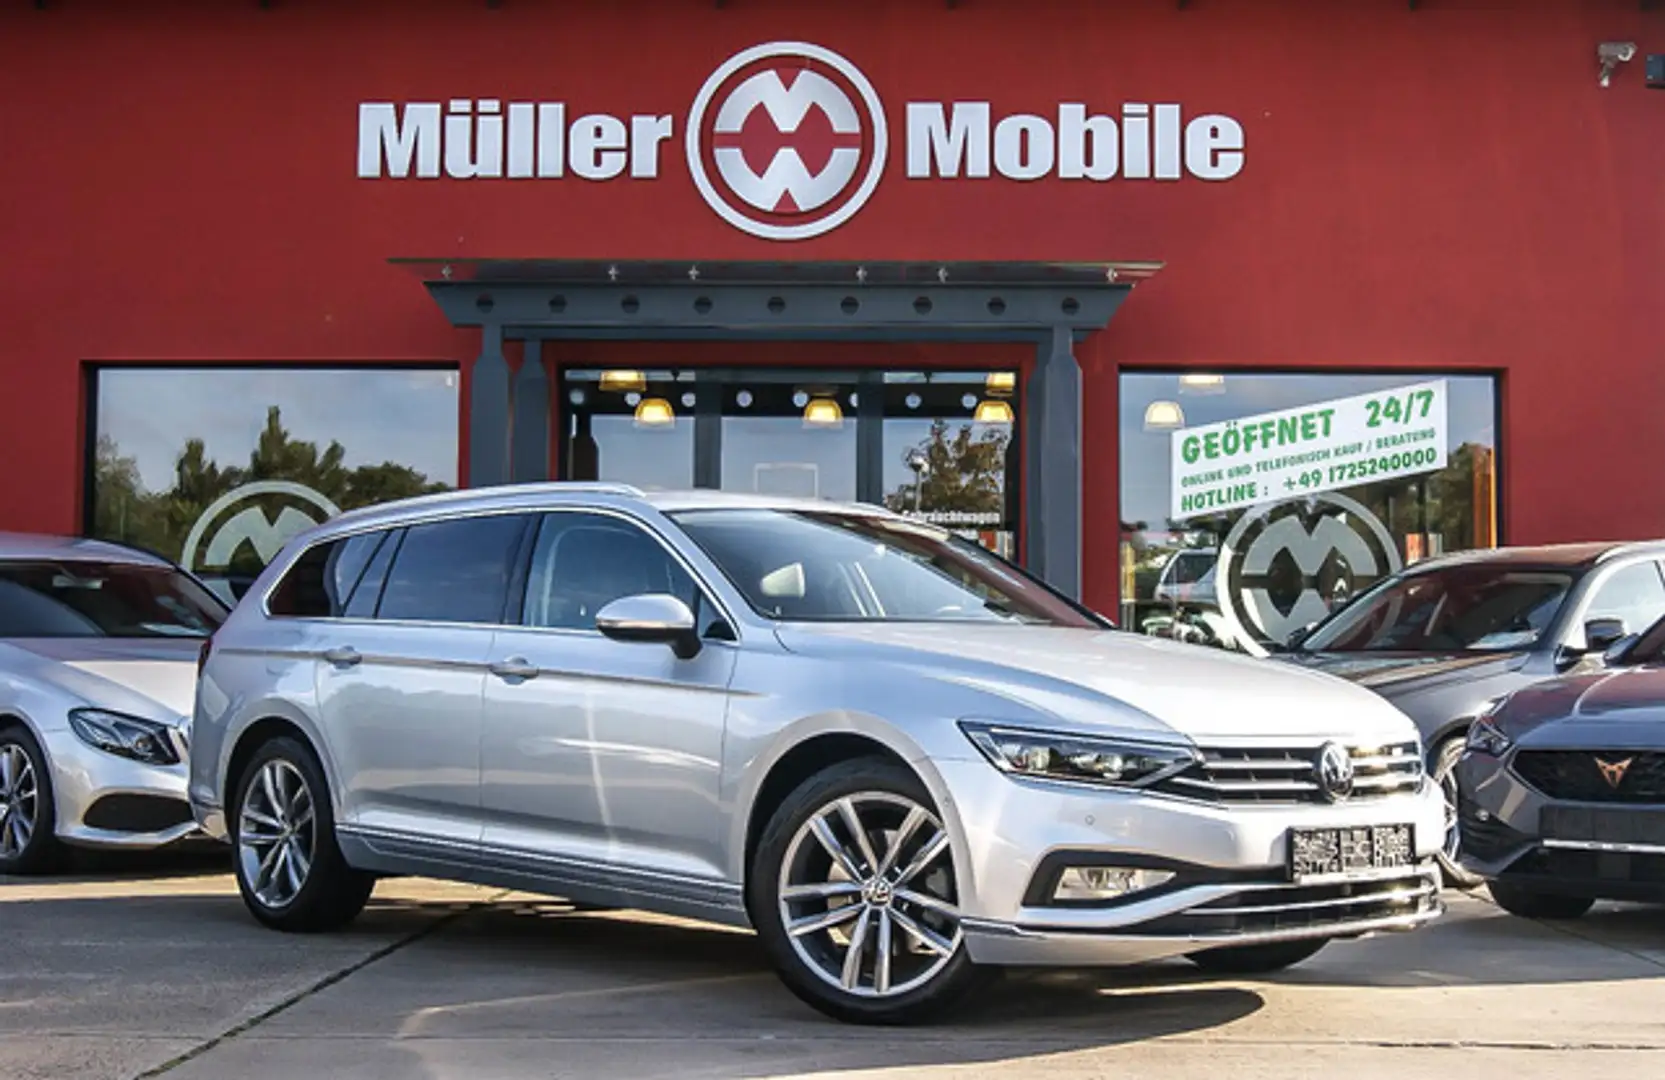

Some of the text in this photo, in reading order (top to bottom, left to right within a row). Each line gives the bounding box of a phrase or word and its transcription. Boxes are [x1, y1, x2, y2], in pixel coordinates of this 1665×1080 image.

[357, 98, 671, 180] Müller
[906, 101, 1246, 181] Mobile
[1182, 389, 1434, 464] GEÖFFNET 24/7
[1181, 482, 1257, 512] HOTLINE
[1283, 469, 1323, 490] +49
[1329, 448, 1437, 483] 1725240000
